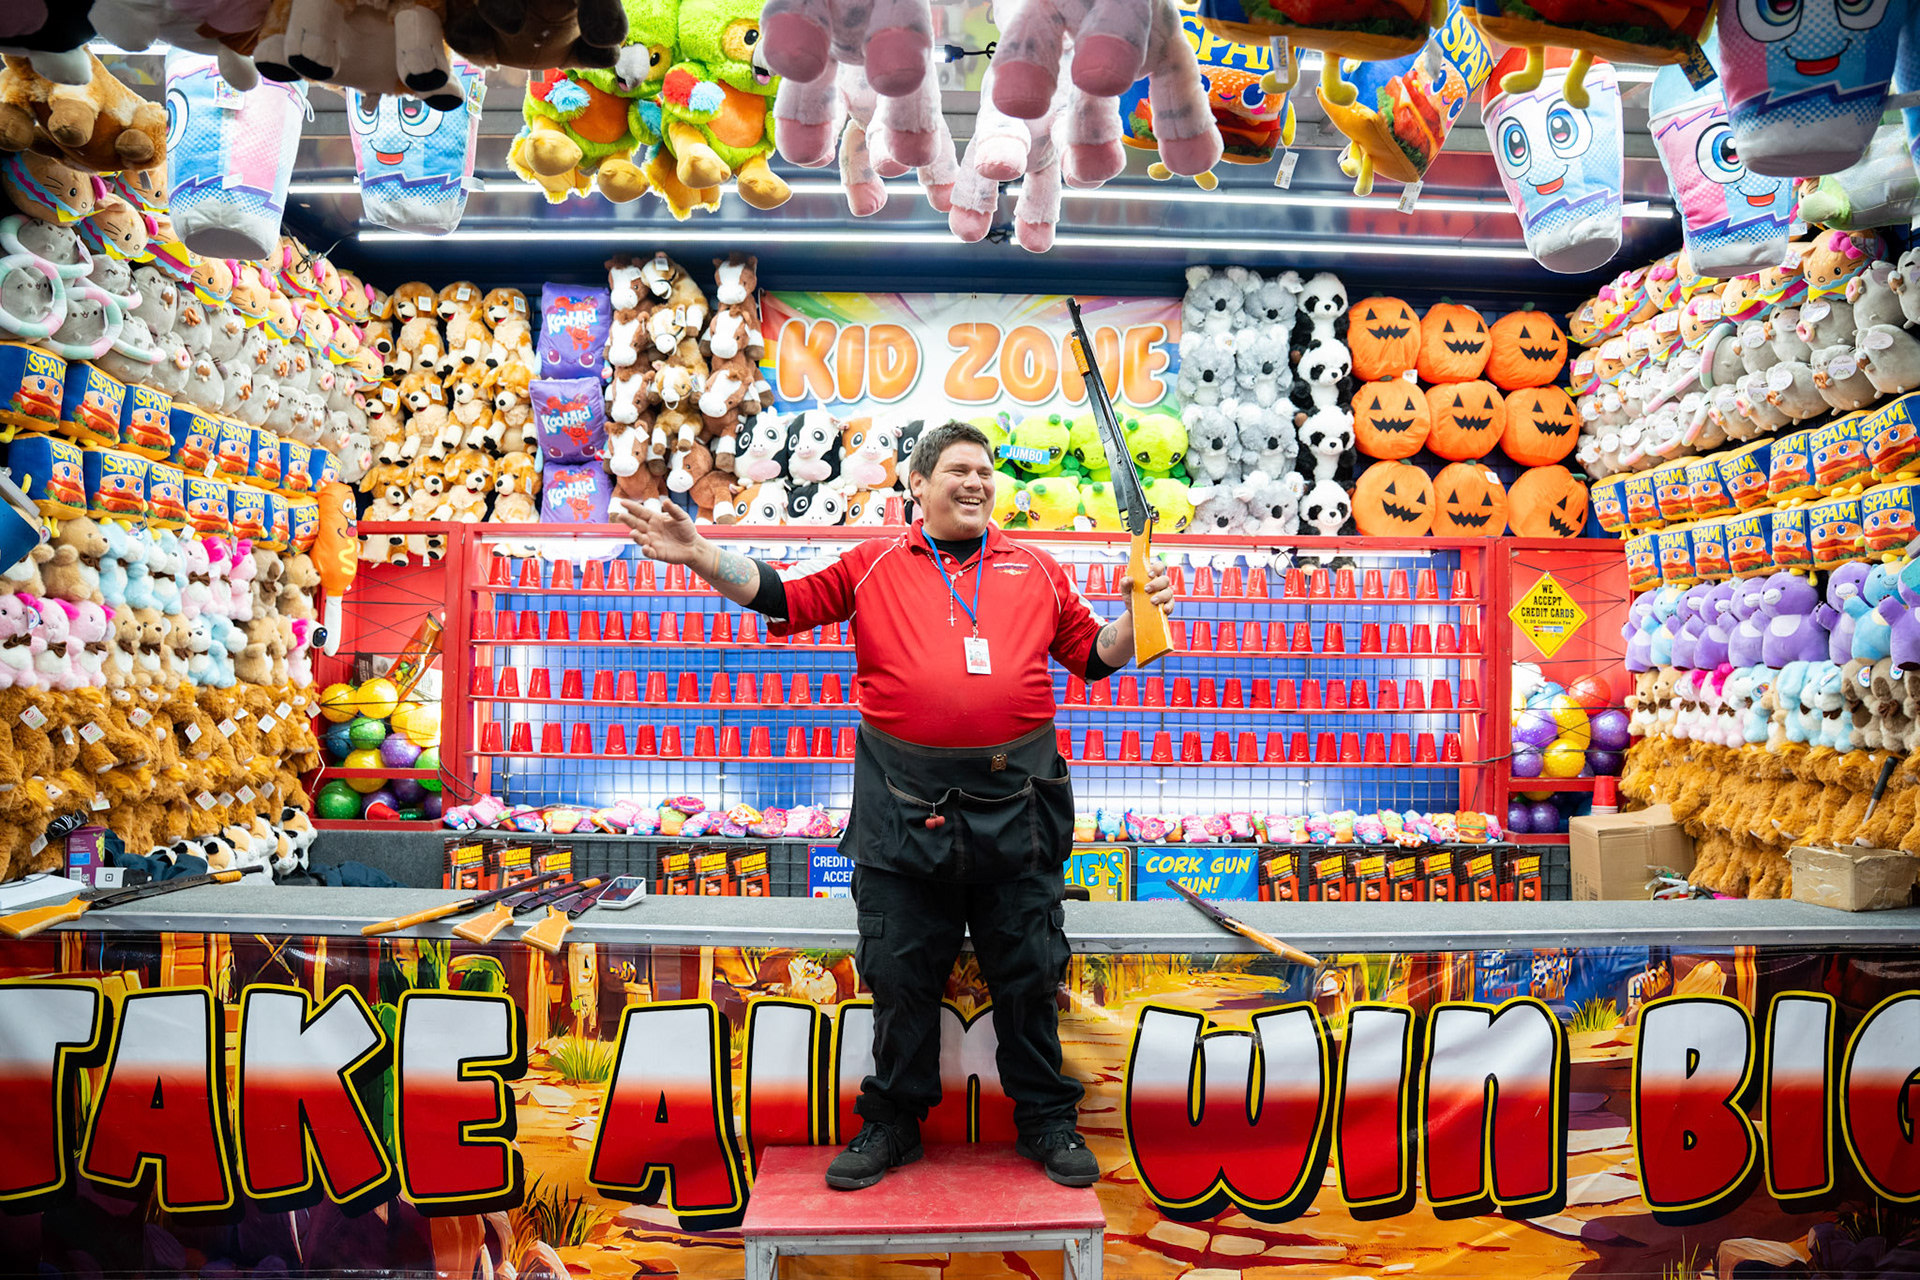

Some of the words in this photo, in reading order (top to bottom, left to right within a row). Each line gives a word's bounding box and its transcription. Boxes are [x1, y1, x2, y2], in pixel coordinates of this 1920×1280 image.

[1181, 15, 1275, 70] SPA
[27, 353, 66, 383] SPAM
[777, 317, 923, 404] KID
[89, 370, 126, 404] SPAM
[135, 388, 172, 415] SPAM
[222, 421, 252, 446] SPAM
[1861, 402, 1907, 443] SPAM
[1770, 434, 1805, 458] SPAM
[1810, 420, 1858, 452] SPAM
[1006, 447, 1043, 462] JUMBO
[104, 454, 148, 479] SPAM
[1653, 469, 1686, 486] SPAM
[1686, 463, 1716, 484] SPAM
[1720, 455, 1757, 481] SPAM
[190, 480, 228, 501] SPAM
[1625, 478, 1650, 496] SPAM
[1863, 487, 1910, 513] SPAM
[1772, 510, 1802, 529] SPAM
[1810, 502, 1858, 525] SPAM
[1692, 525, 1721, 543] SPAM
[1725, 518, 1760, 540] SPAM
[1625, 535, 1651, 557] SPAM
[1659, 532, 1685, 550] SPAM
[1542, 584, 1553, 594] WE
[1533, 596, 1562, 606] ACCEPT
[1521, 607, 1548, 617] CREDIT
[1550, 608, 1574, 618] CARDS
[813, 856, 848, 867] CREDIT
[1145, 856, 1204, 873] CORK
[1210, 856, 1251, 874] GUN
[1178, 876, 1221, 894] FUN!
[0, 983, 522, 1214] TAKE
[1631, 990, 1920, 1214] BIG
